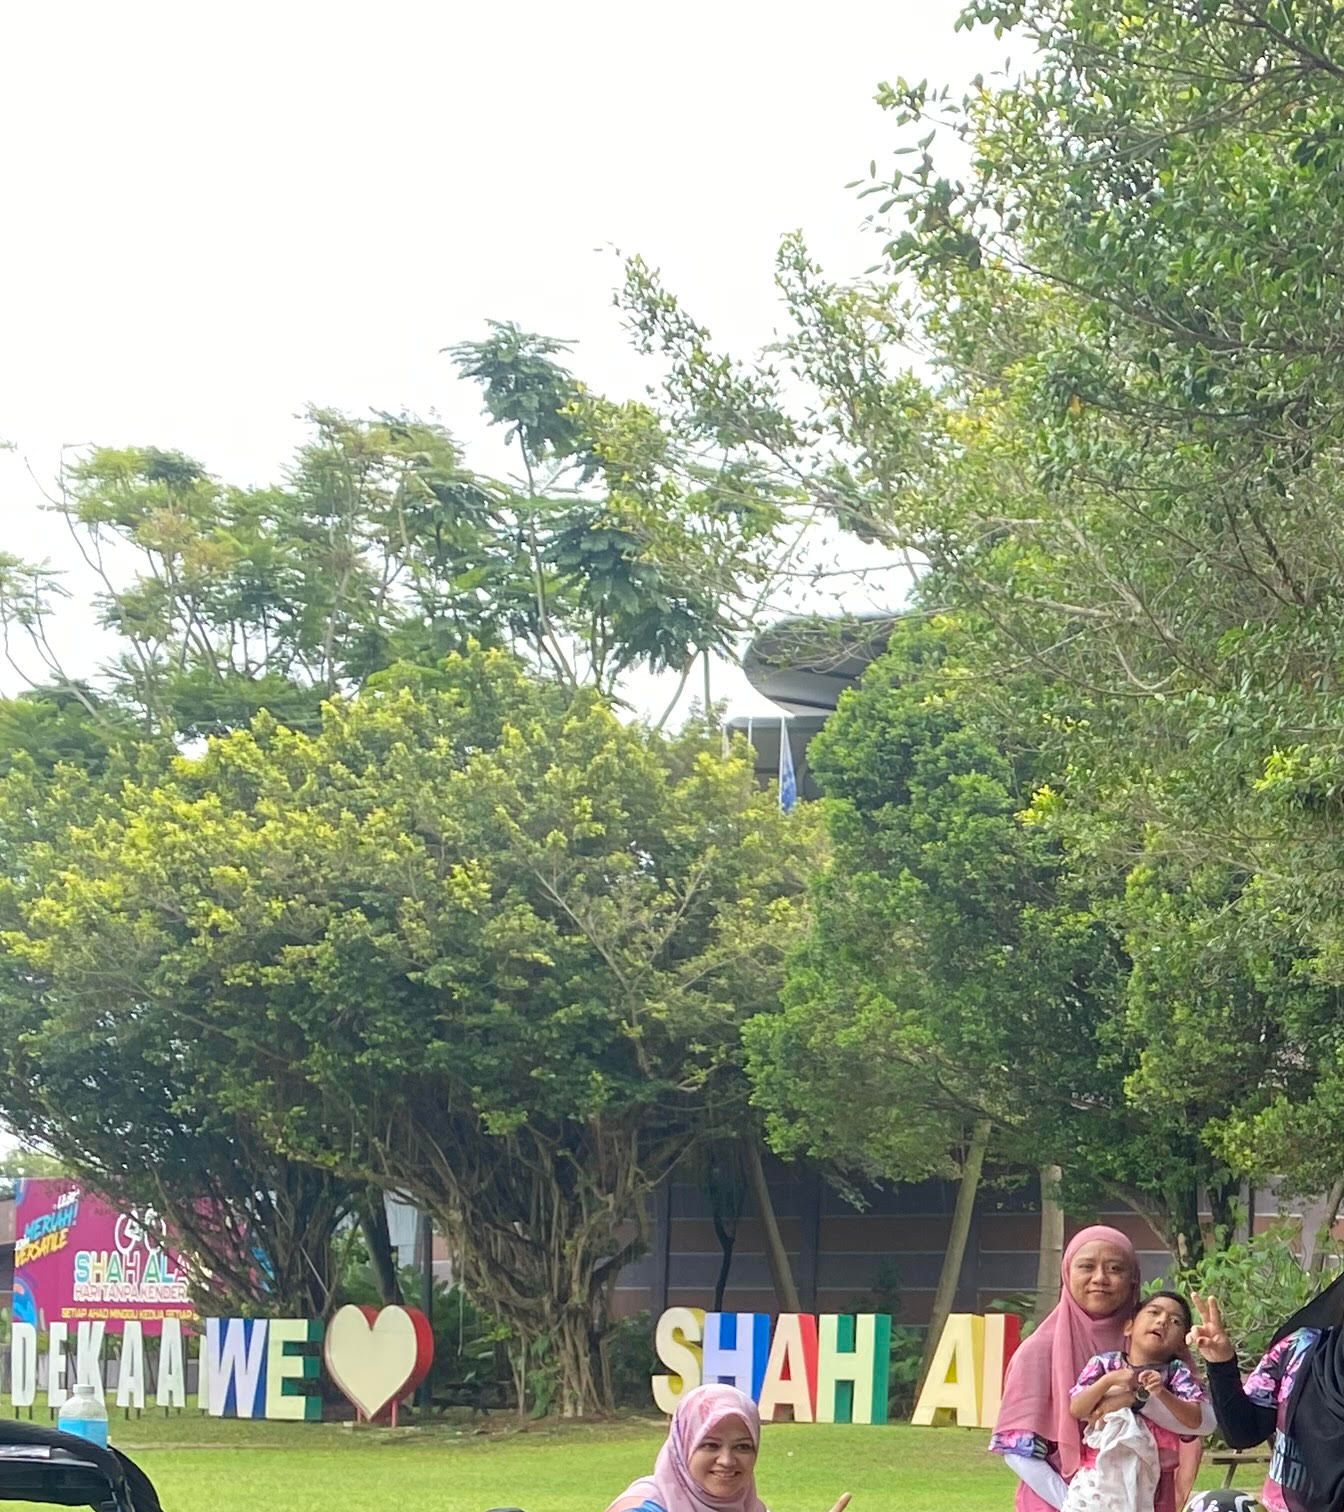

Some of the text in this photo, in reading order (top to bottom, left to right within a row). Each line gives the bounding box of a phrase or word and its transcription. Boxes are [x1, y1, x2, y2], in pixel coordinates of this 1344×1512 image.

[74, 1250, 140, 1284] SHAH
[140, 1283, 190, 1303] KENDER
[11, 1319, 208, 1410] DEKAA
[205, 1317, 314, 1420] WE
[651, 1307, 890, 1424] SHAH
